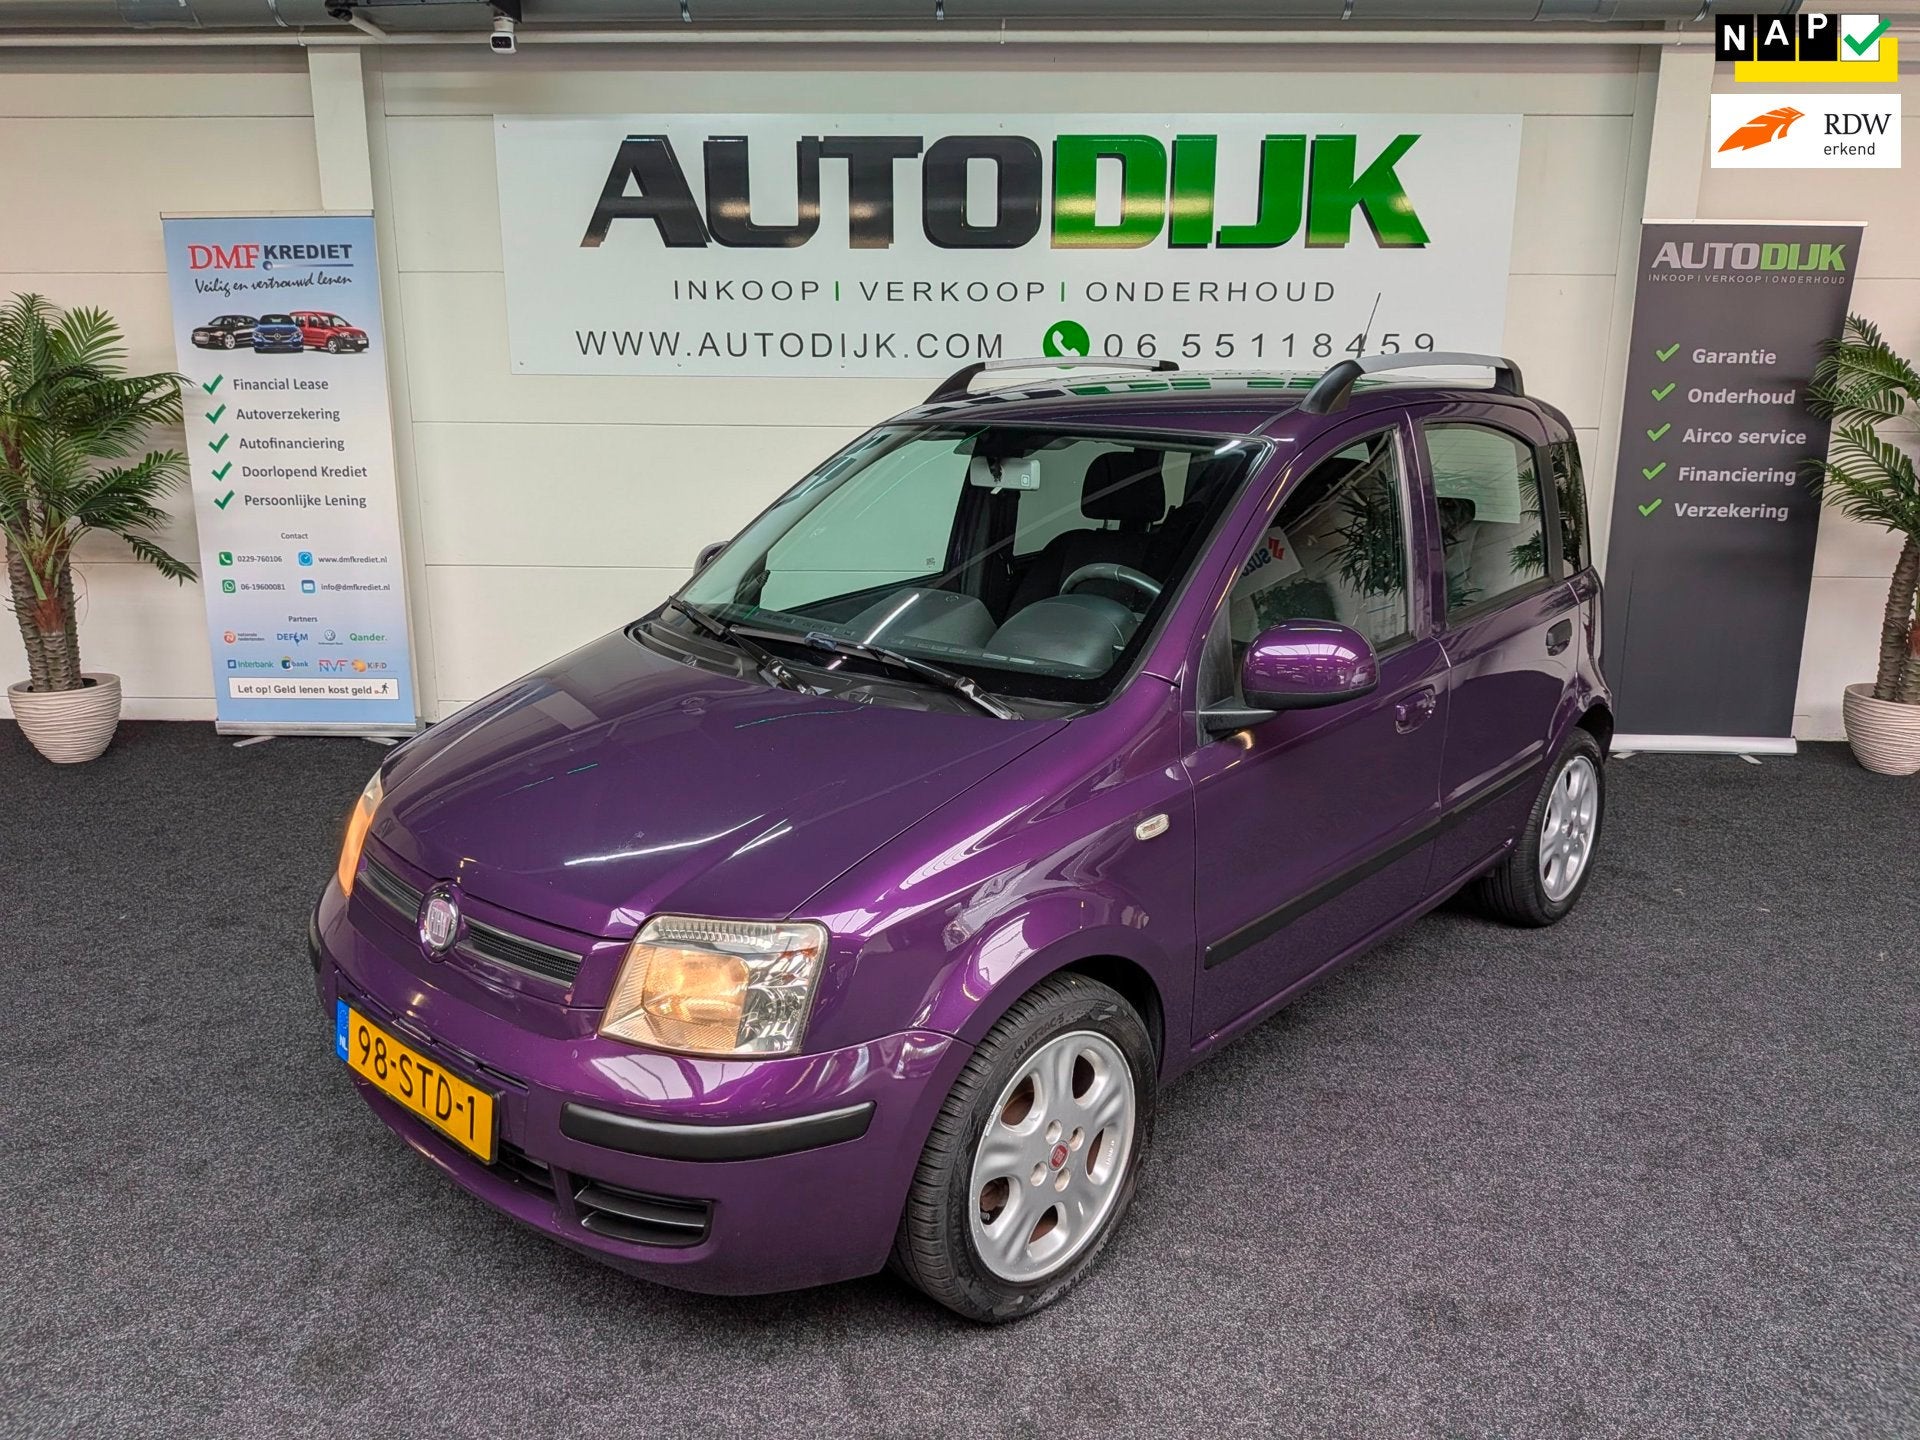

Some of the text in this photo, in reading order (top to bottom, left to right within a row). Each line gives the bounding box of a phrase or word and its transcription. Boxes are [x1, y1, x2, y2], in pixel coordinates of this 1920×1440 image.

[579, 134, 1431, 249] AUTODIJK
[187, 244, 353, 270] DMF KREDIET
[1650, 241, 1847, 272] AUTODIJK
[194, 271, 353, 298] Veilig en vertrouwd lenen
[1086, 281, 1336, 303] ONDERHOUD
[575, 330, 1004, 359] WWW.AUTODIJK.COM
[1103, 332, 1436, 359] 06 55118459
[1691, 348, 1778, 365] Garantie
[232, 378, 330, 391] Financial Lease
[1687, 388, 1796, 405] Onderhoud
[235, 408, 341, 423] Autoverzekering
[238, 437, 346, 452] Autofinanciering
[1682, 428, 1808, 445] Airco service
[241, 465, 368, 480] Doorlopend Krediet
[1678, 466, 1797, 487] Financiering
[243, 494, 368, 509] Persoonlijke Lening
[1674, 502, 1790, 522] Verzekering
[280, 532, 309, 541] Contact
[318, 555, 388, 564] www.dmfkrediet.nl
[320, 583, 391, 592] info@dmfkrediet.nl
[287, 615, 319, 623] Partners
[237, 659, 275, 669] Interbank
[237, 684, 373, 697] Let op! Geld lenen kost geld
[338, 1033, 349, 1052] NL
[358, 1025, 476, 1141] 98-STD-1
